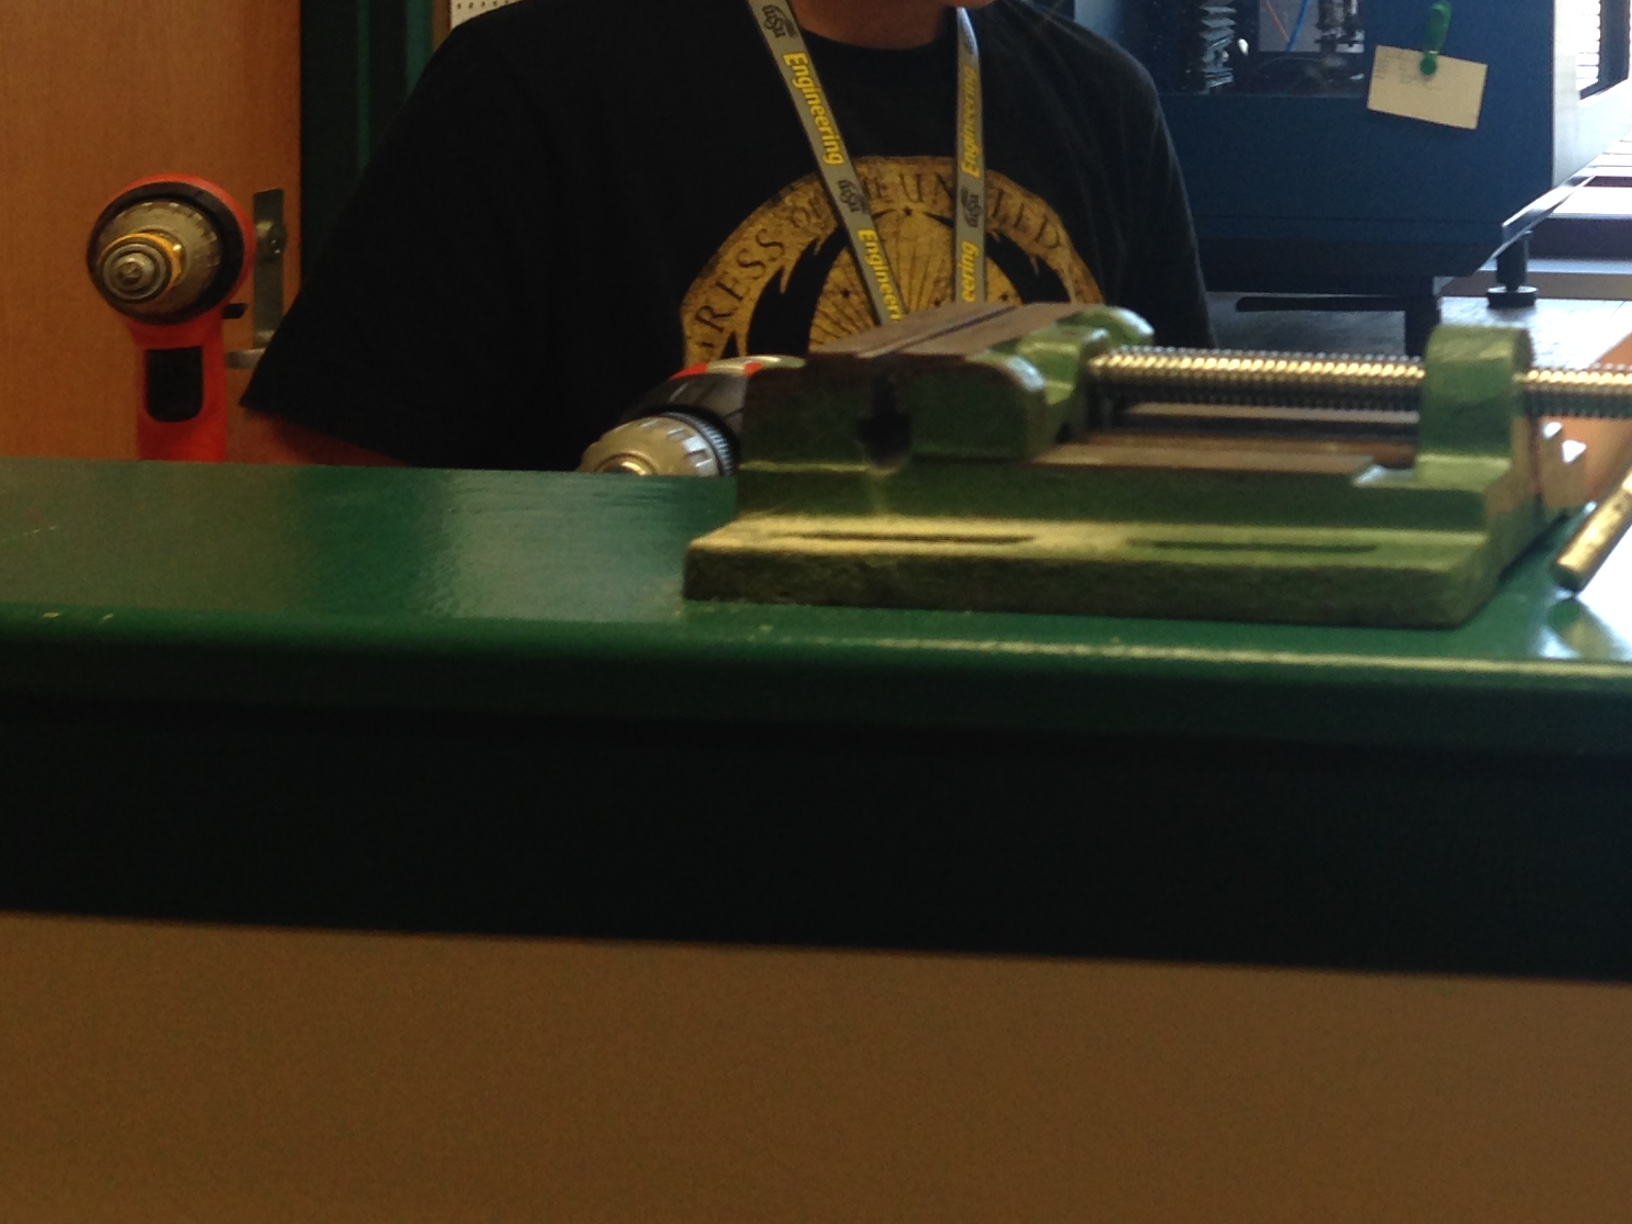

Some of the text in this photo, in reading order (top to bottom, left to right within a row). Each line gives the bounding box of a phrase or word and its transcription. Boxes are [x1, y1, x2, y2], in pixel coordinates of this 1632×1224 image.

[783, 51, 844, 166] Engineering
[960, 65, 981, 178] Engineering
[695, 228, 786, 349] RESS
[857, 229, 903, 321] Engineeri
